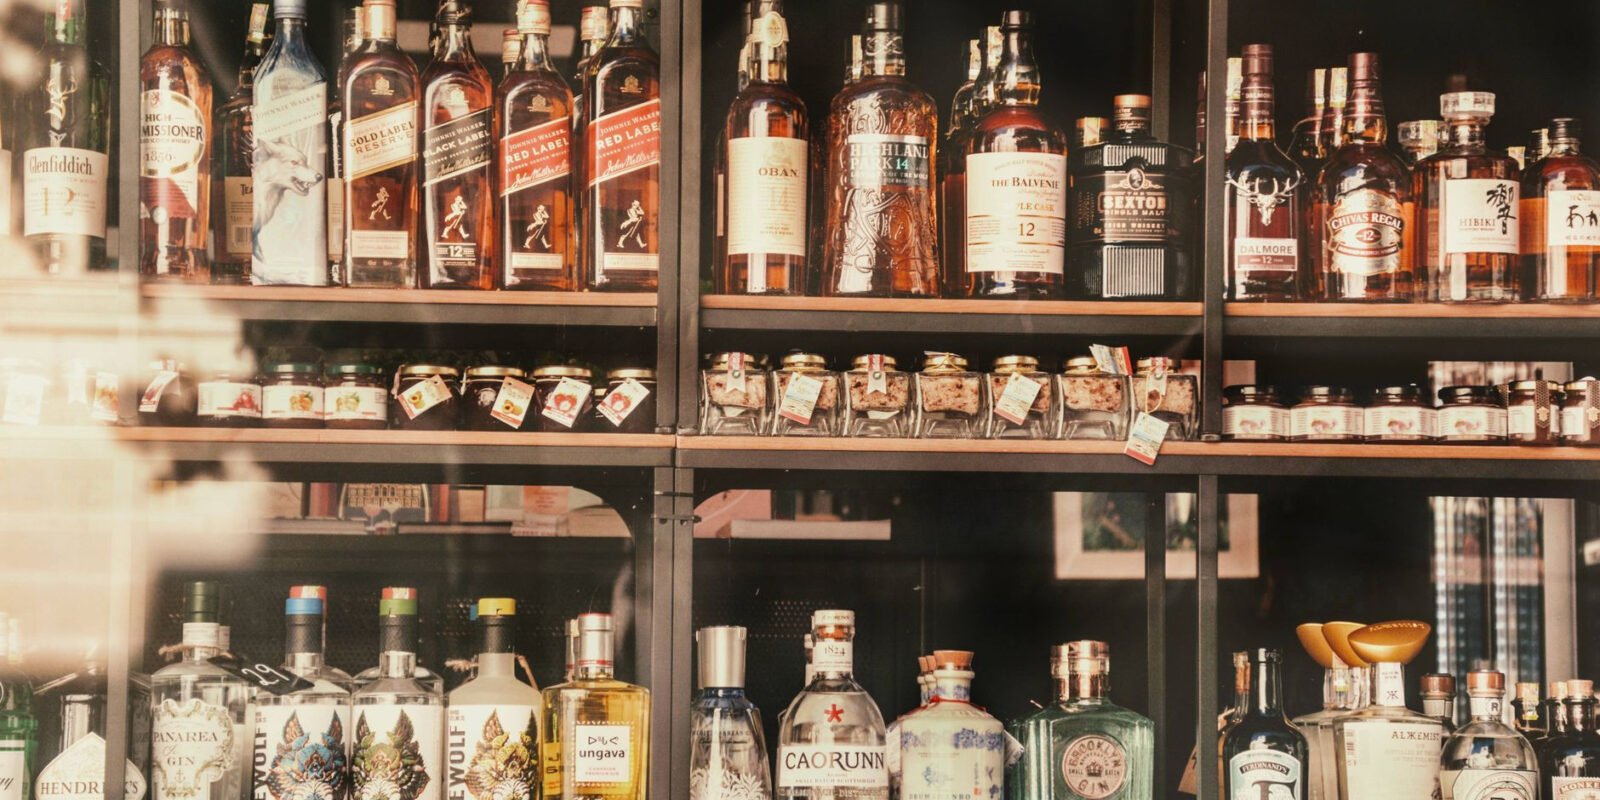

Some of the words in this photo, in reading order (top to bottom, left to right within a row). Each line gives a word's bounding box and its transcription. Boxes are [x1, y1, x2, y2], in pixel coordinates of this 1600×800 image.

[350, 131, 378, 148] GOLD
[380, 121, 415, 137] LABEL
[599, 120, 632, 137] JOHNNIE
[355, 130, 414, 154] RESERVE
[428, 130, 456, 144] JOHNNIE
[595, 134, 623, 151] RED
[625, 122, 660, 139] LABE
[422, 141, 457, 159] BLACK
[457, 130, 491, 146] LABEL
[504, 150, 530, 165] RED
[532, 137, 569, 156] LABEL
[509, 137, 538, 152] JOHNNIE
[895, 157, 909, 170] 14
[758, 167, 800, 178] OBAN
[991, 179, 1007, 188] THE
[1103, 195, 1167, 210] SEXTON
[1331, 212, 1370, 230] CHIVAS
[1371, 212, 1403, 230] REGAL
[1459, 218, 1496, 227] HIBIKI
[1019, 222, 1036, 237] 12
[1362, 229, 1375, 241] 12
[448, 245, 464, 258] 12
[1239, 245, 1294, 255] DALMORE
[1261, 255, 1273, 265] 12
[824, 643, 847, 657] 1824
[1491, 702, 1499, 711] R
[153, 731, 219, 743] PANAREA
[578, 749, 626, 761] ungava
[1068, 739, 1121, 768] BROOKLYN
[167, 757, 196, 766] GIN
[785, 751, 886, 772] CAORUNN
[1241, 762, 1289, 775] FERDINAND'S
[40, 780, 139, 796] HENDR'S
[1078, 779, 1110, 794] GIN
